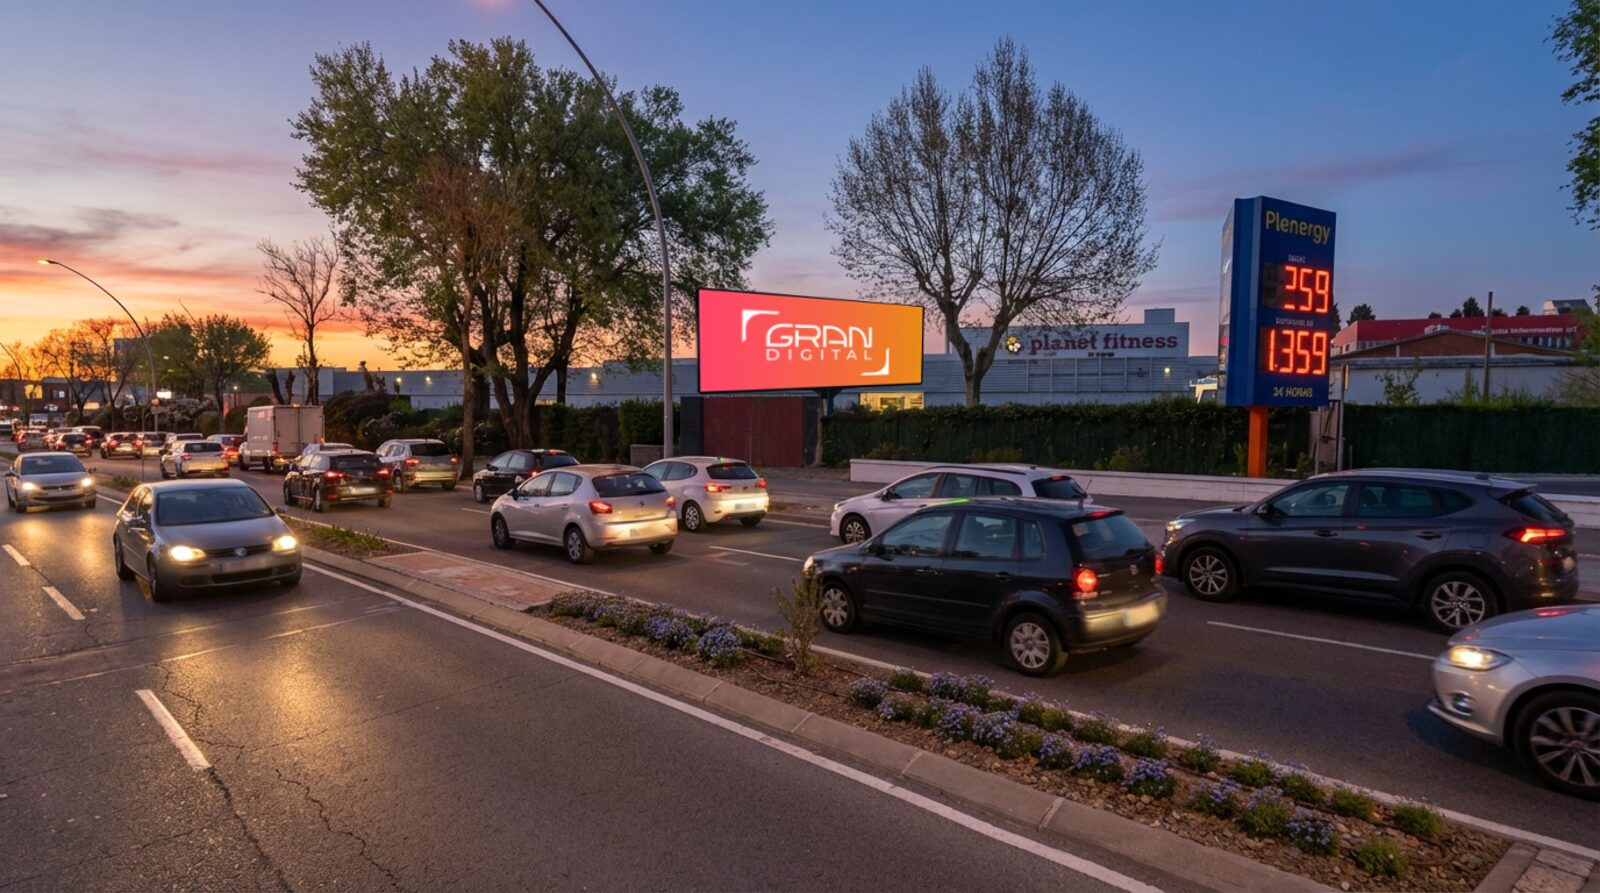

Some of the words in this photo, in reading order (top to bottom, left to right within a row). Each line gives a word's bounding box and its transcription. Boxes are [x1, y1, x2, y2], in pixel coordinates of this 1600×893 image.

[1265, 210, 1331, 245] Plenergy
[765, 323, 873, 348] GRAN
[1028, 333, 1097, 356] planet
[1103, 332, 1179, 350] fitness
[765, 348, 873, 361] DIGITAL
